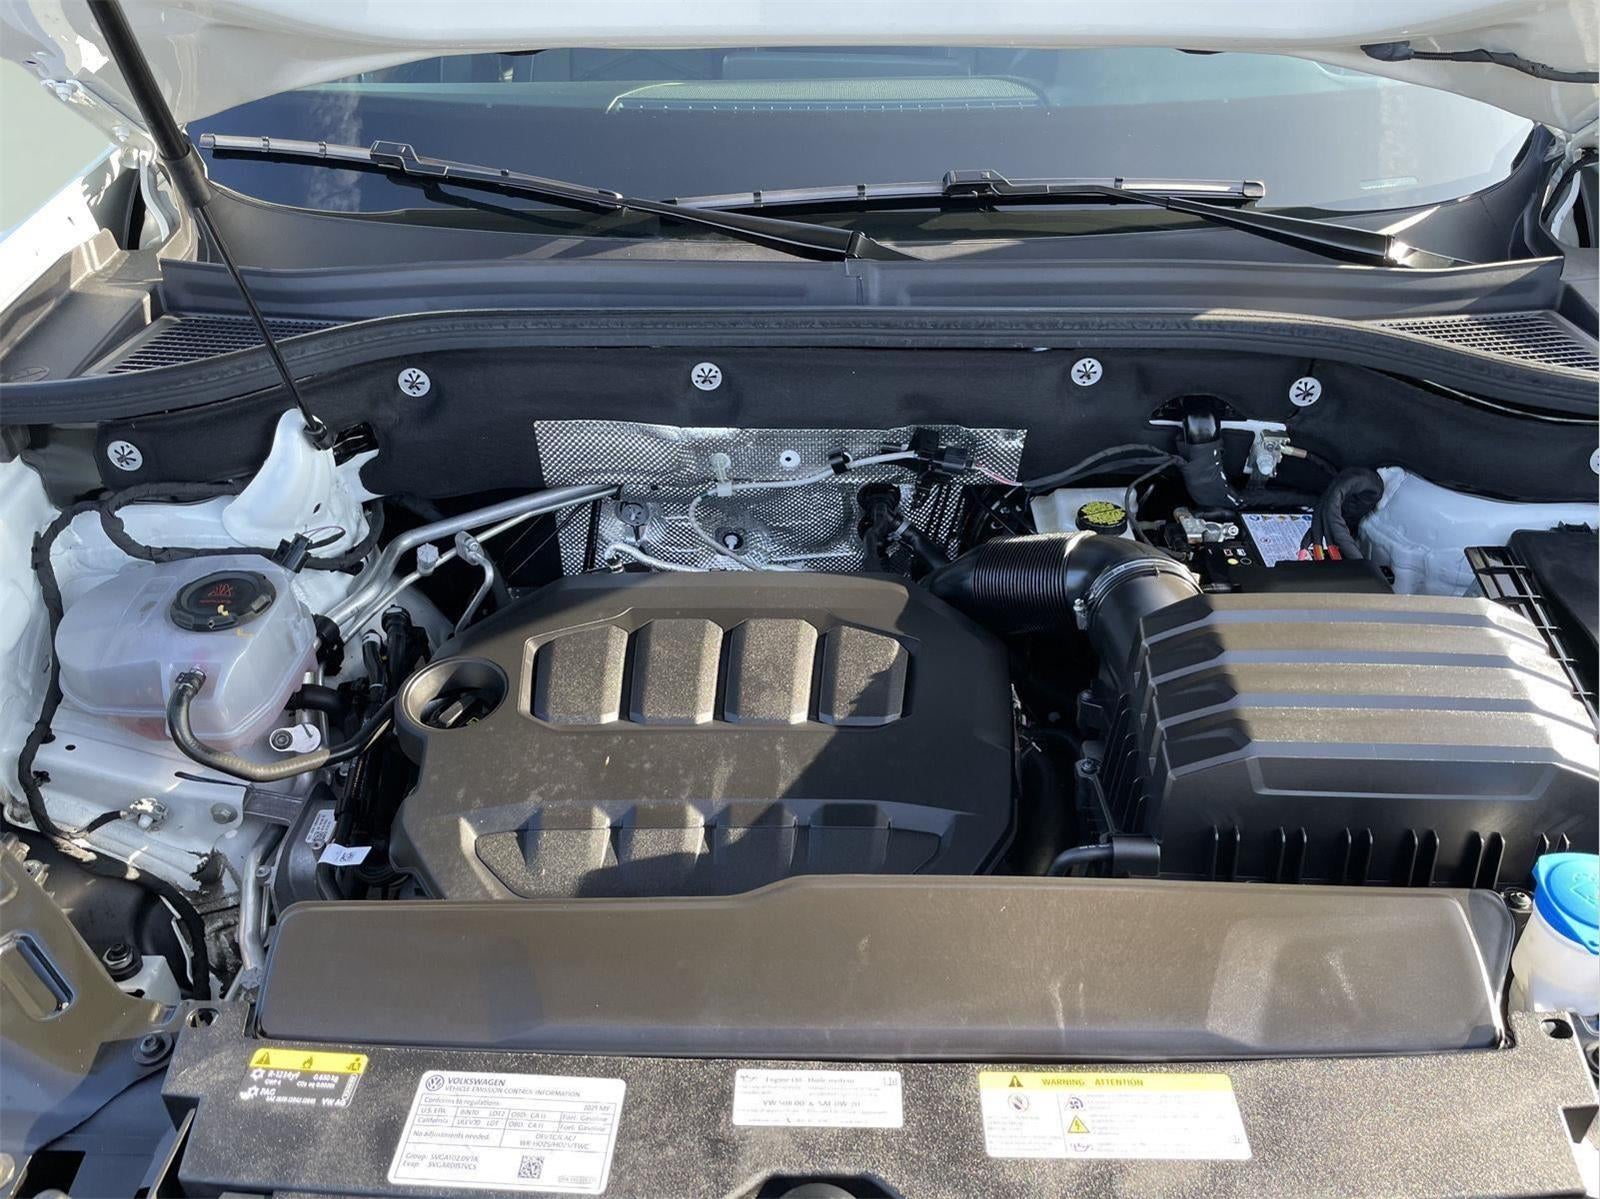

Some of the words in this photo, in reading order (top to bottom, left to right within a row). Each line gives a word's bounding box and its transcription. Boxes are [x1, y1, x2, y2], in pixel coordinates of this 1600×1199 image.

[448, 1077, 506, 1087] VOLKSWAGEN
[1041, 1078, 1085, 1086] WARNING
[1094, 1078, 1144, 1087] ATTENTION
[504, 1088, 533, 1096] CONTROL
[535, 1089, 581, 1097] INFORMATION
[424, 1096, 455, 1104] Conforms
[580, 1115, 608, 1123] Gasoline
[578, 1124, 606, 1132] Gasoline
[423, 1131, 463, 1139] adjustments
